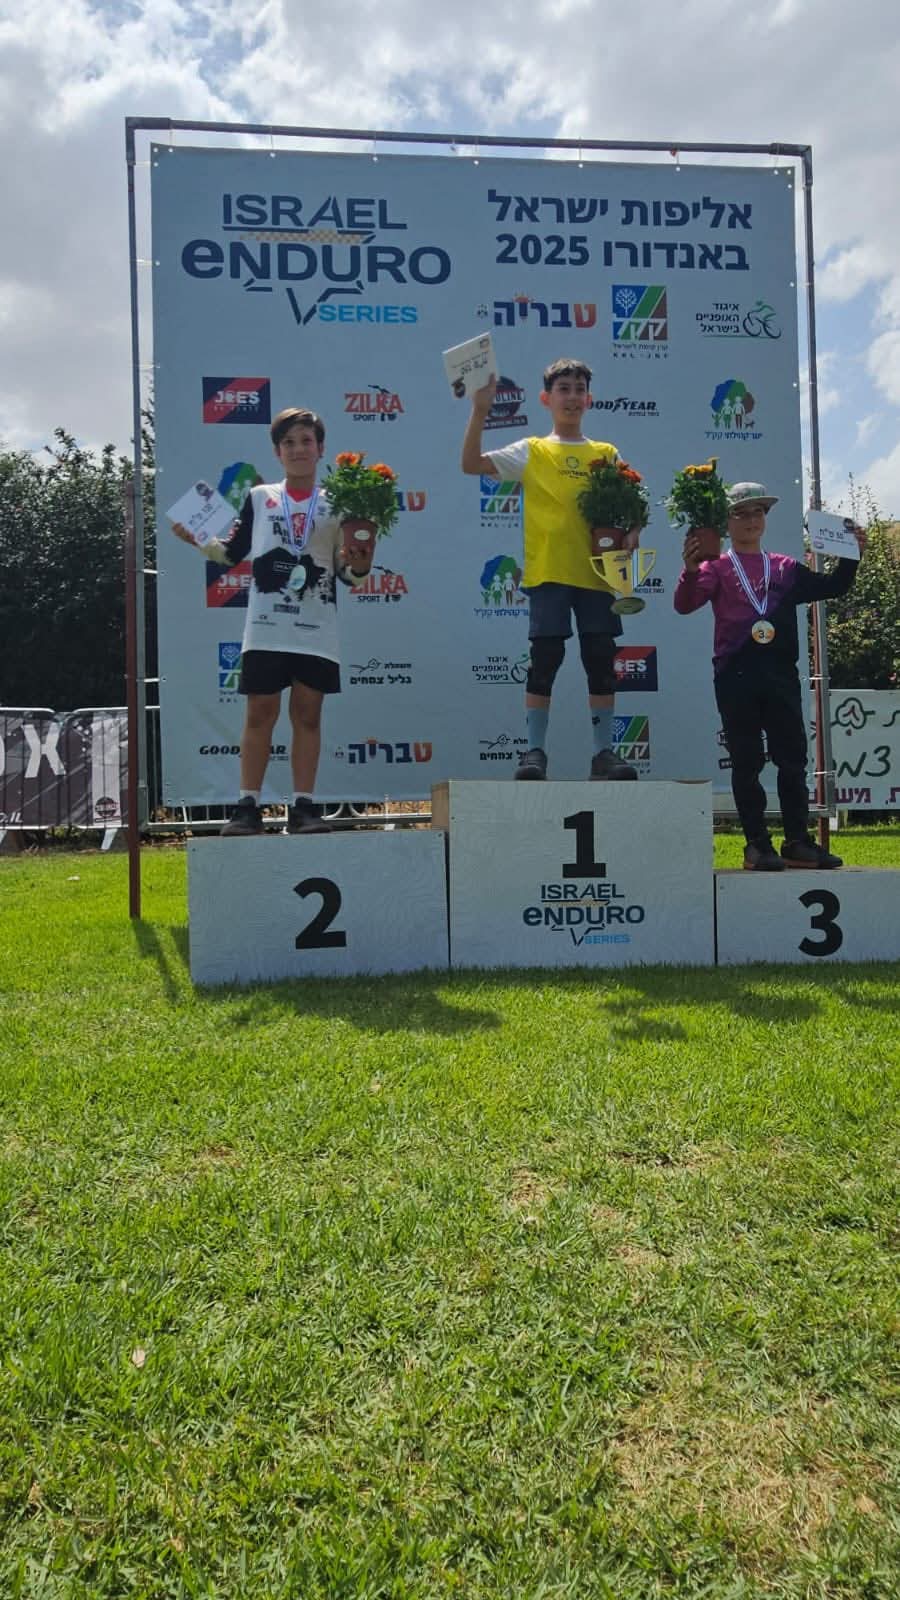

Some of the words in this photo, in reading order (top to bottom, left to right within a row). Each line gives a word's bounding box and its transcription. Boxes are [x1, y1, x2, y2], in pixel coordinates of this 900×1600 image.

[222, 194, 408, 230] ISRAEL
[488, 189, 609, 224] ישראל
[621, 196, 753, 229] אליפות
[495, 234, 590, 266] 2025
[603, 241, 750, 270] באנדורו
[319, 304, 418, 323] SERIES
[494, 300, 597, 328] טבריה
[713, 303, 740, 311] איגוד
[695, 313, 740, 322] האופניים
[700, 323, 740, 333] בישראל
[344, 393, 405, 413] ZILKA
[353, 414, 376, 422] SPORT
[217, 574, 256, 587] JOE
[618, 567, 628, 581] 1
[758, 629, 766, 640] 3
[613, 659, 648, 672] OES
[350, 677, 384, 685] צמחים
[387, 674, 412, 684] גליל
[475, 673, 509, 681] בישראל
[348, 741, 433, 764] טבריה
[480, 752, 513, 761] צמחים
[562, 810, 607, 878] 1
[541, 883, 625, 899] ISRAEL
[293, 877, 347, 950] 2
[798, 889, 843, 957] 3
[584, 934, 632, 945] SERIES
